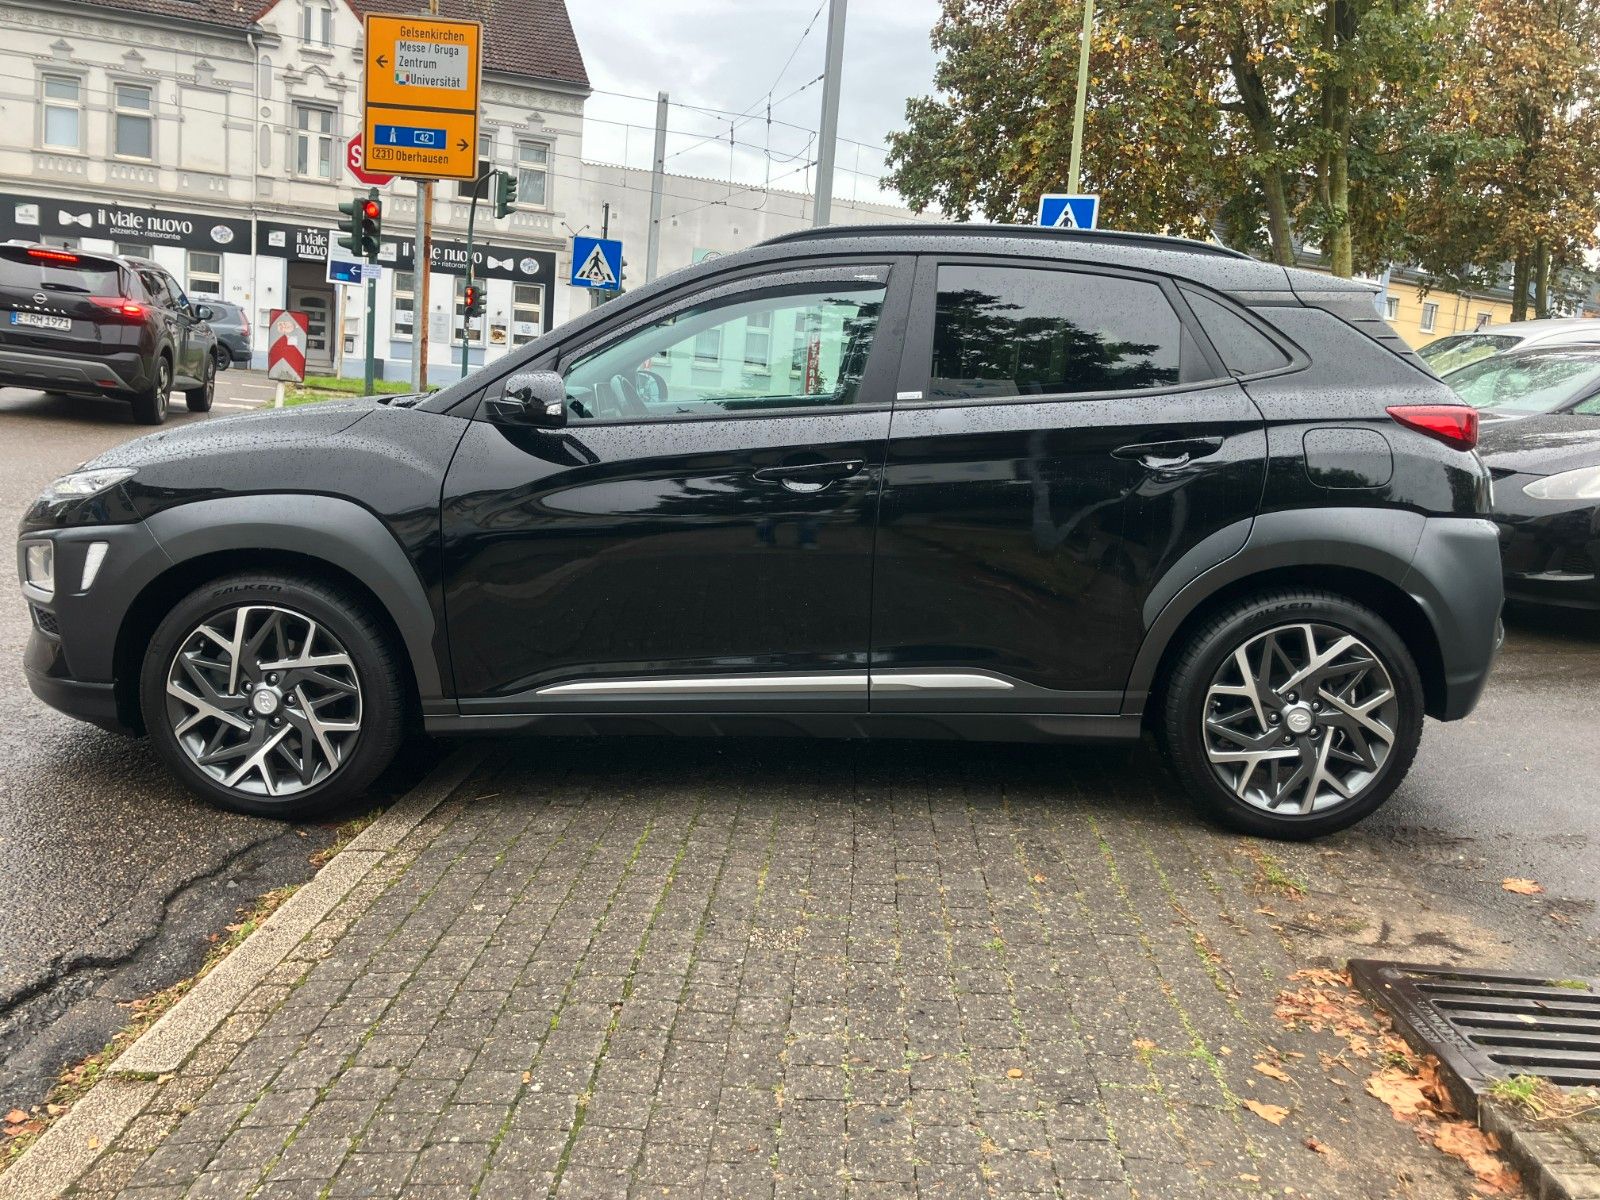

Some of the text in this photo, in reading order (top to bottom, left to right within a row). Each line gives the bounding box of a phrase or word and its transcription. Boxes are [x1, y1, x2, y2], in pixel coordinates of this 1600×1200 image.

[400, 25, 465, 41] Gelsenkirchen
[399, 41, 459, 57] Messe / Gruga
[398, 55, 437, 70] Zentrum
[410, 74, 461, 88] Universität
[419, 135, 430, 143] 42
[375, 150, 393, 159] 231
[395, 151, 449, 165] Oberhausen
[97, 209, 106, 225] il
[109, 211, 144, 229] viale
[147, 216, 193, 234] nuovo
[109, 227, 182, 241] pizzeria ristorante
[296, 232, 302, 244] il
[304, 233, 328, 247] viale
[296, 244, 328, 256] nuovo
[402, 242, 410, 257] il
[444, 247, 483, 264] nuoo
[441, 261, 469, 270] ristoran
